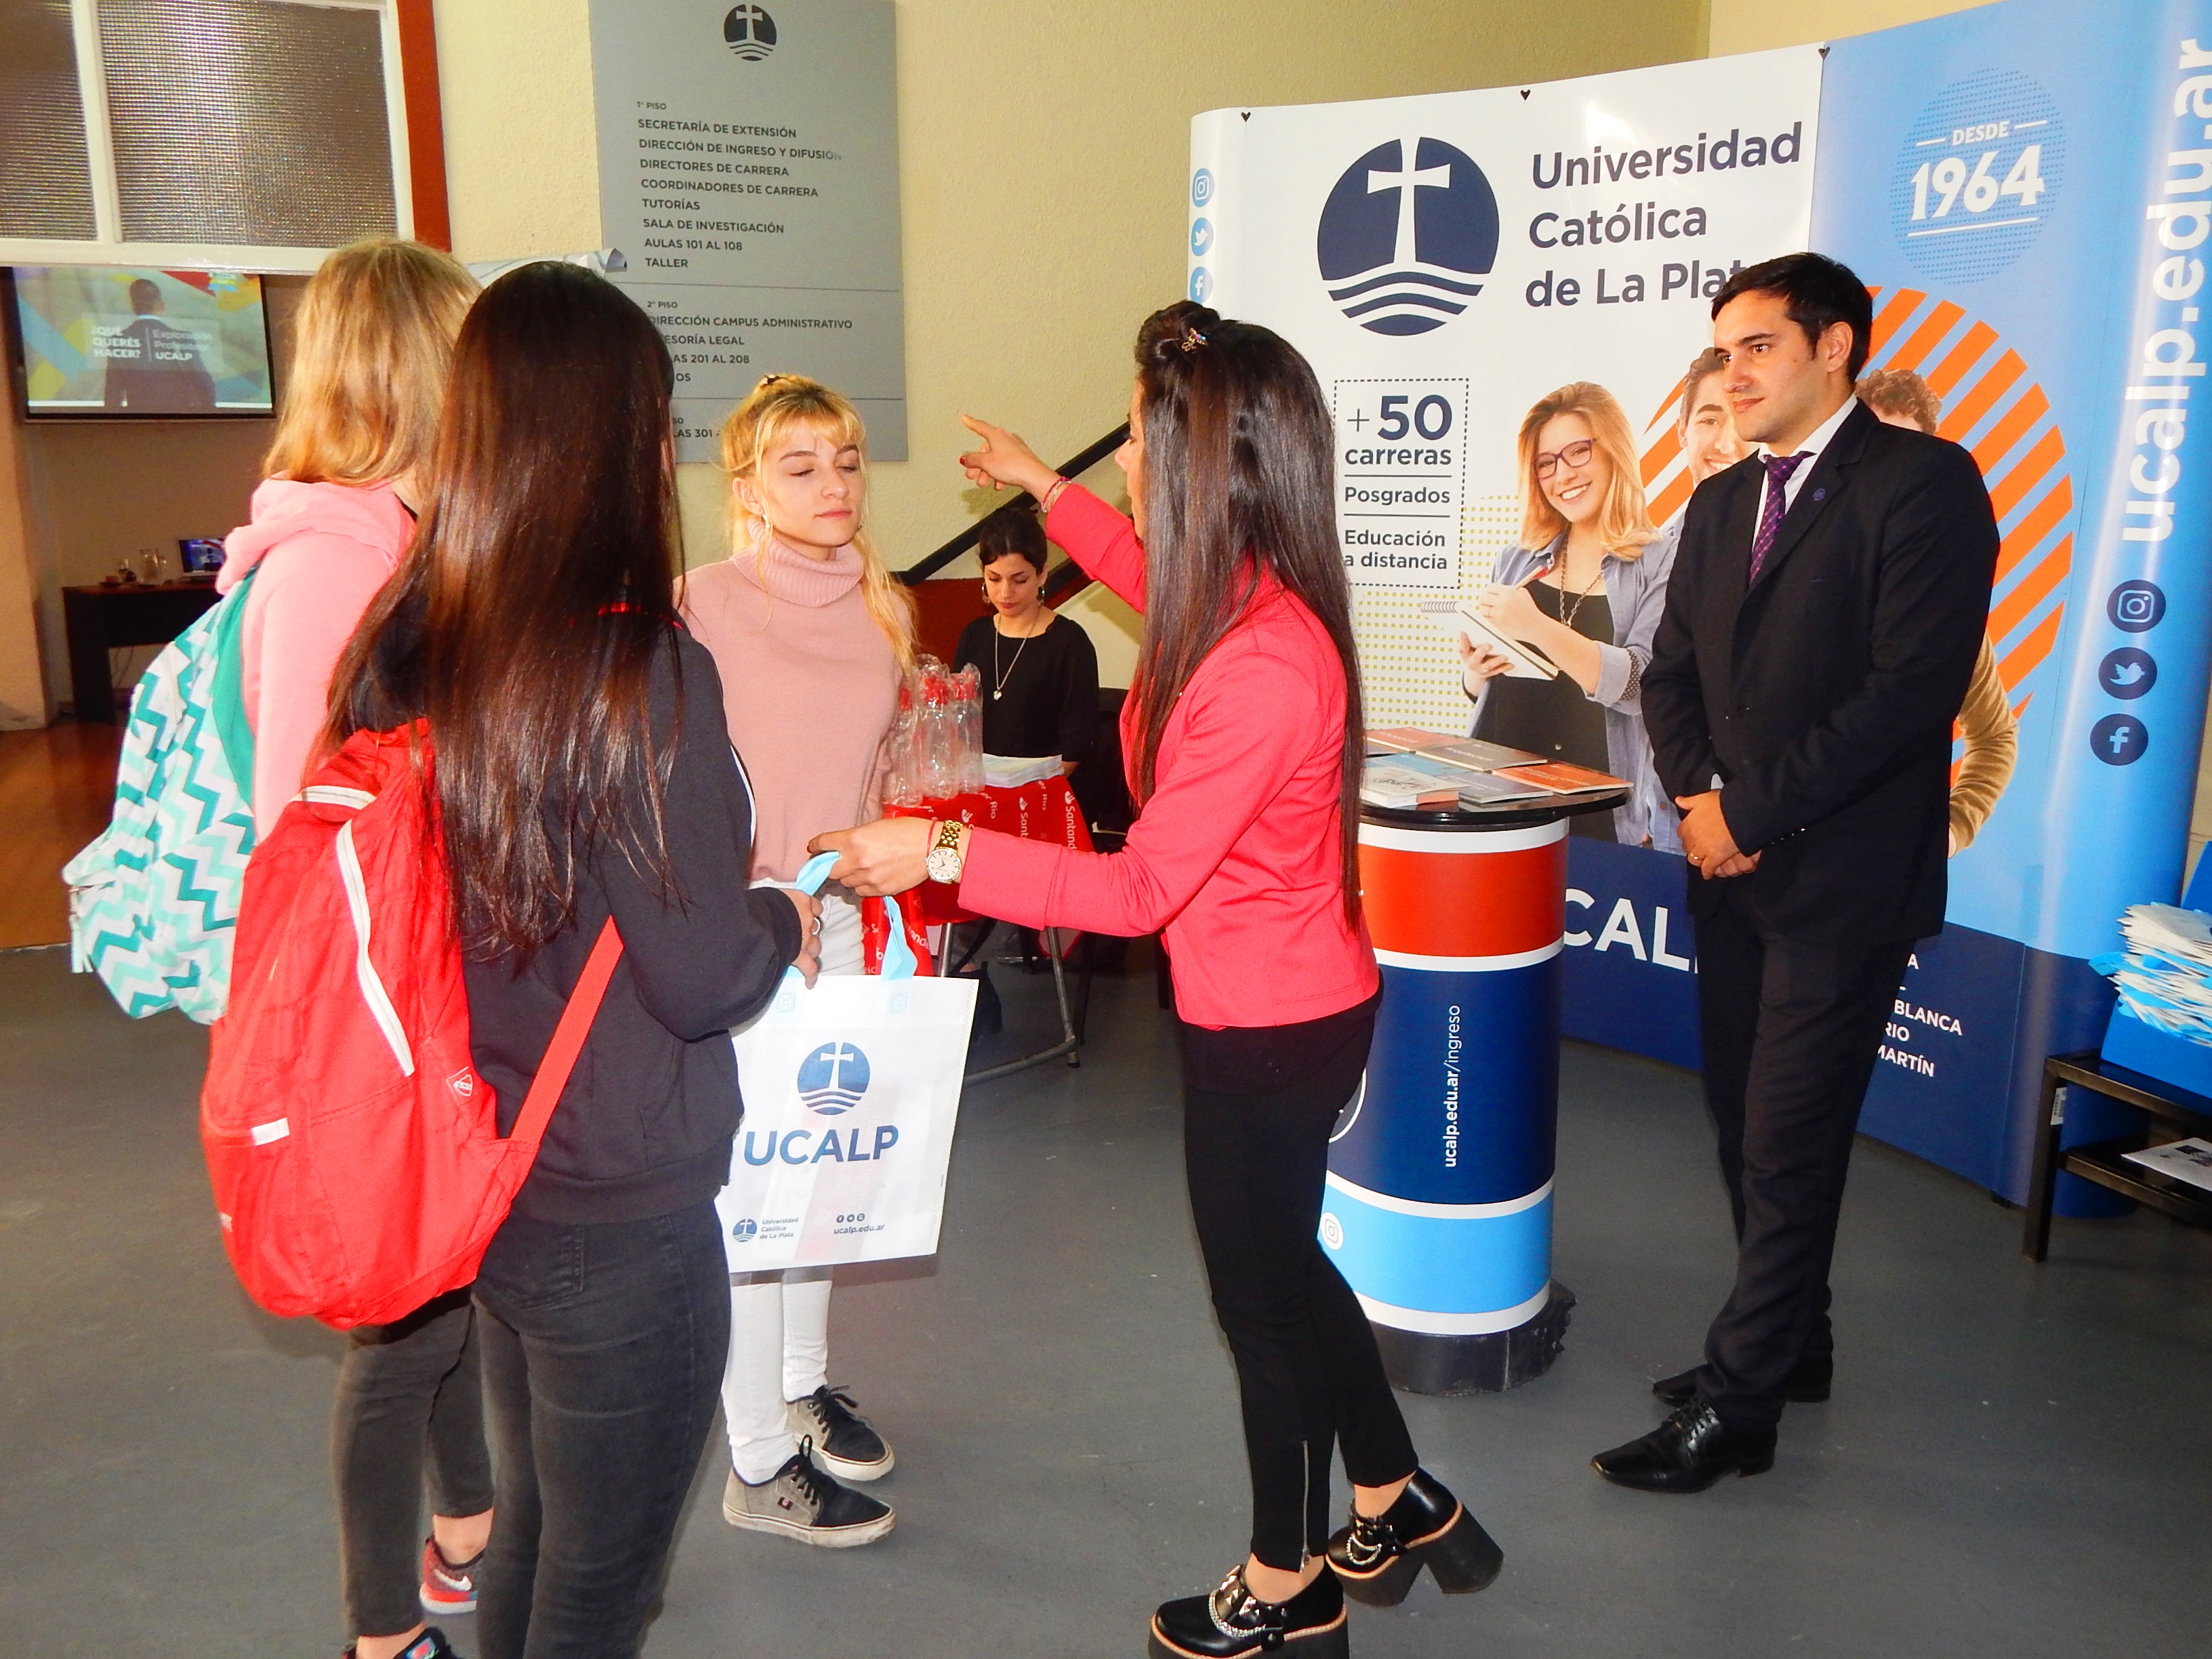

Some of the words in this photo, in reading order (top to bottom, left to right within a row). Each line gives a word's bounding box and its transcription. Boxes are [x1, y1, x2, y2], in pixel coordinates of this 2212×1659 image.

[647, 102, 667, 110] PISO
[638, 119, 711, 132] SECRETARÍA
[714, 123, 729, 134] DE
[732, 125, 797, 138] EXTENSIÓN
[1952, 121, 2009, 146] DESDE
[639, 139, 703, 152] DIRECCIÓN
[707, 142, 722, 153] DE
[725, 144, 776, 157] INGRESO
[779, 148, 786, 157] Y
[790, 148, 842, 161] DIFUSIÓN
[1532, 122, 1801, 190] Universidad
[640, 159, 714, 172] DIRECTORES
[717, 163, 732, 173] DE
[735, 164, 790, 176] CARRERA
[641, 179, 744, 193] COORDINADORES
[747, 184, 762, 194] DE
[765, 185, 819, 197] CARRERA
[1910, 144, 2045, 222] 1964
[642, 197, 700, 211] TUTORÍAS
[643, 218, 674, 229] SALA
[677, 220, 693, 230] DE
[696, 220, 784, 234] INVESTIGACIÓN
[1529, 203, 1707, 249] Católica
[644, 238, 683, 249] AULAS
[686, 239, 703, 249] 101
[706, 240, 721, 250] AL
[724, 241, 743, 251] 108
[645, 258, 689, 268] TALLER
[1525, 270, 1580, 308] de
[1597, 266, 1645, 304] La
[1662, 260, 1746, 300] Pla
[2123, 39, 2212, 542] ucalp.edu.ar
[658, 301, 678, 309] PISO
[650, 315, 710, 326] DIRECCIÓN
[714, 317, 759, 327] CAMPUS
[762, 319, 853, 329] ADMINISTRATIVO
[665, 333, 705, 344] ESORÍA
[709, 336, 745, 345] LEGAL
[95, 349, 141, 359] HACER?
[155, 352, 192, 361] UCALP
[691, 354, 708, 363] 201
[712, 354, 726, 363] AL
[729, 354, 750, 364] 208
[695, 429, 712, 437] 301
[1345, 449, 1452, 465] carreras
[1345, 487, 1450, 506] Posgrados
[1345, 529, 1446, 547] Educación
[1345, 554, 1354, 566] a
[1361, 552, 1448, 569] distancia
[1065, 806, 1077, 849] Santand
[1564, 888, 1698, 975] CAL
[1893, 999, 1963, 1036] BLANCA
[1443, 1005, 1462, 1168] ucalp.edu.ar/ingreso
[744, 1125, 899, 1166] UCALP
[834, 1224, 885, 1234] ucalp.edu.ar
